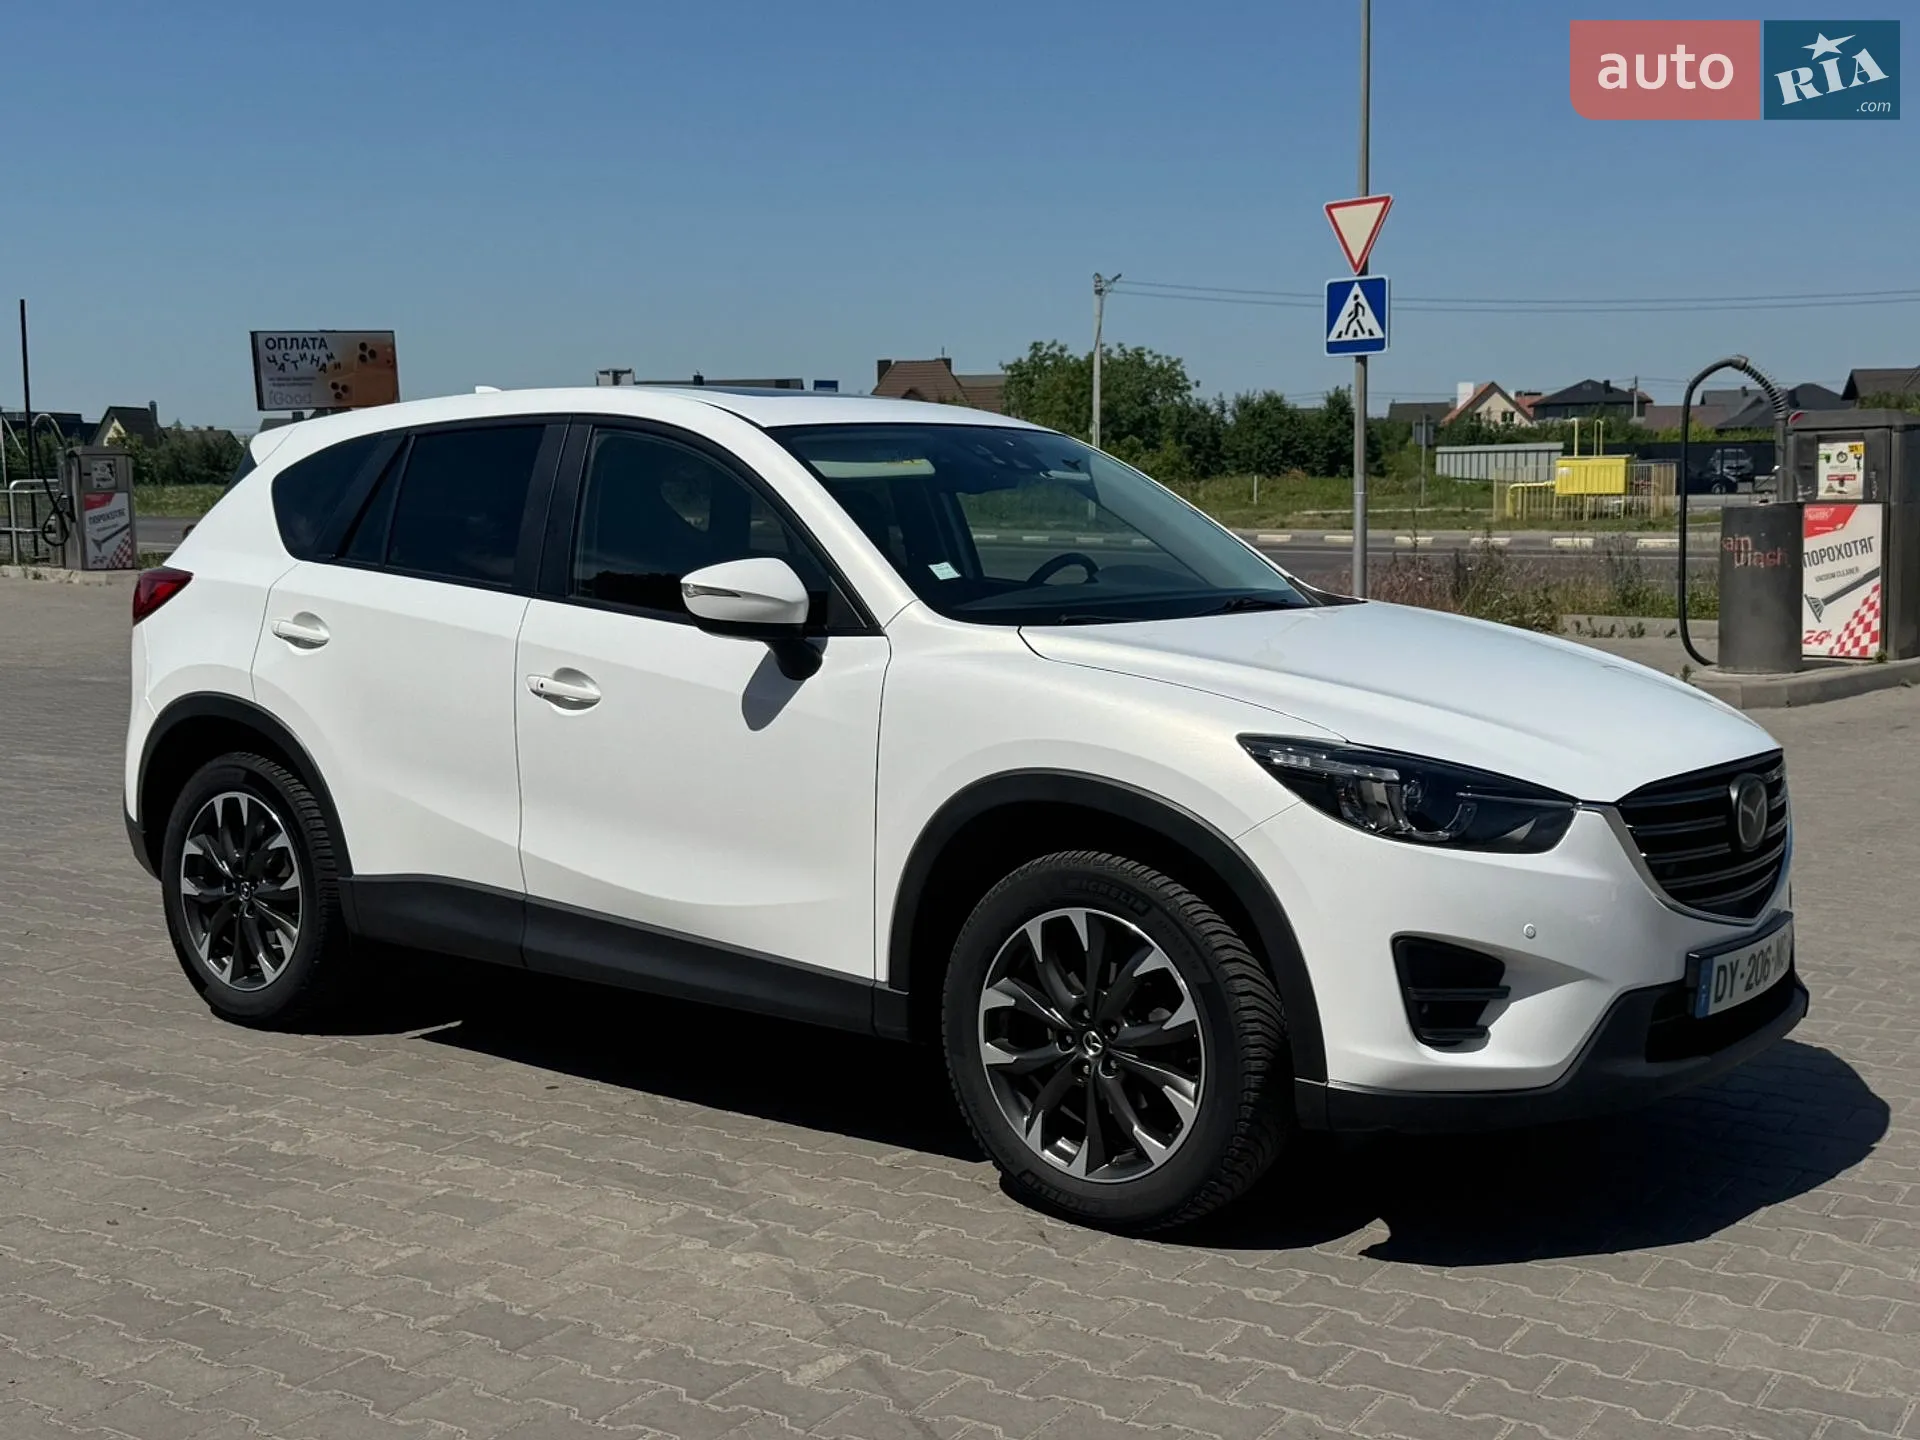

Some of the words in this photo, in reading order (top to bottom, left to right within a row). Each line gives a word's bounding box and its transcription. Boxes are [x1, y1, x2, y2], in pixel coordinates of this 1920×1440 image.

[265, 337, 328, 350] ОПЛАТА
[266, 352, 342, 374] ЧАСТИНАМИ
[1802, 536, 1874, 568] ПОРОХОТЯГ
